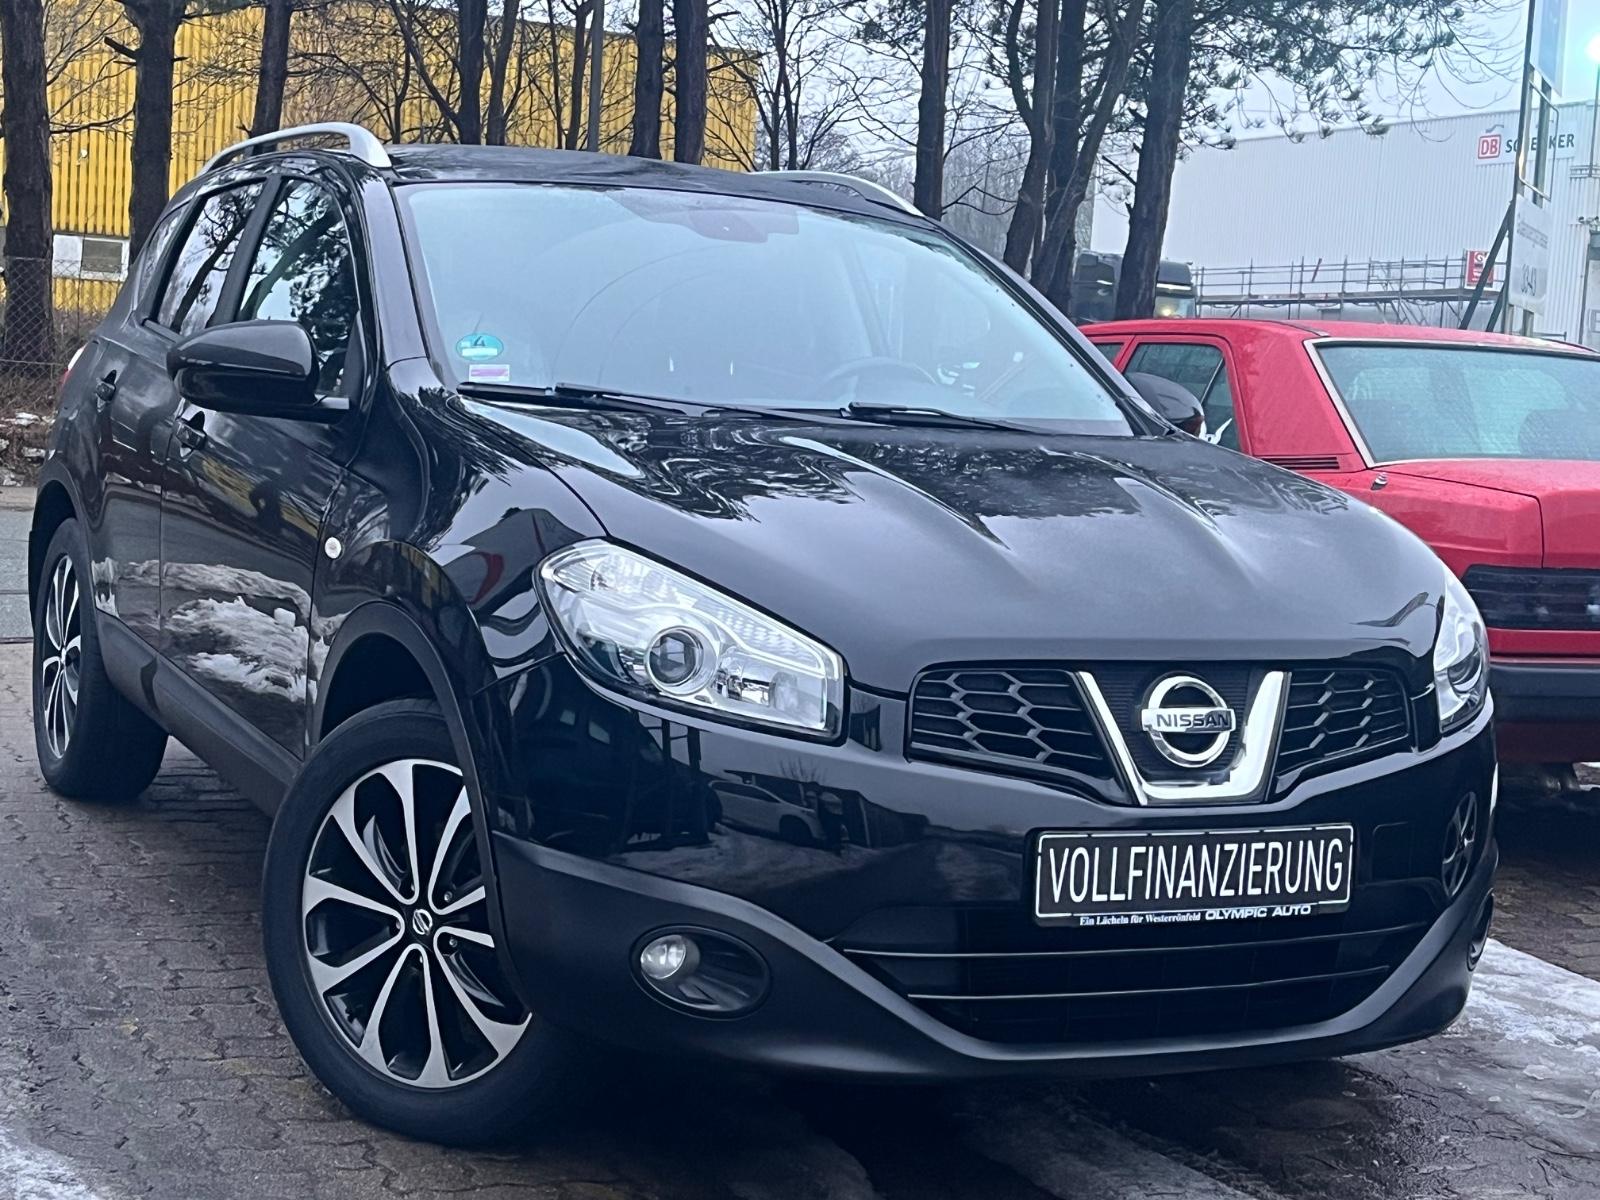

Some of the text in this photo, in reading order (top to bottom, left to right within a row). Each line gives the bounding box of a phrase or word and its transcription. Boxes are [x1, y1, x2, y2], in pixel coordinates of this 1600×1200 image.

[1480, 138, 1499, 156] DB
[1156, 713, 1230, 728] NISSAN
[1049, 838, 1343, 903] VOLLFINANZIERUNG
[1080, 904, 1312, 926] Ein Lächeln für Westerrönfeld OLYMPIC AUTO
